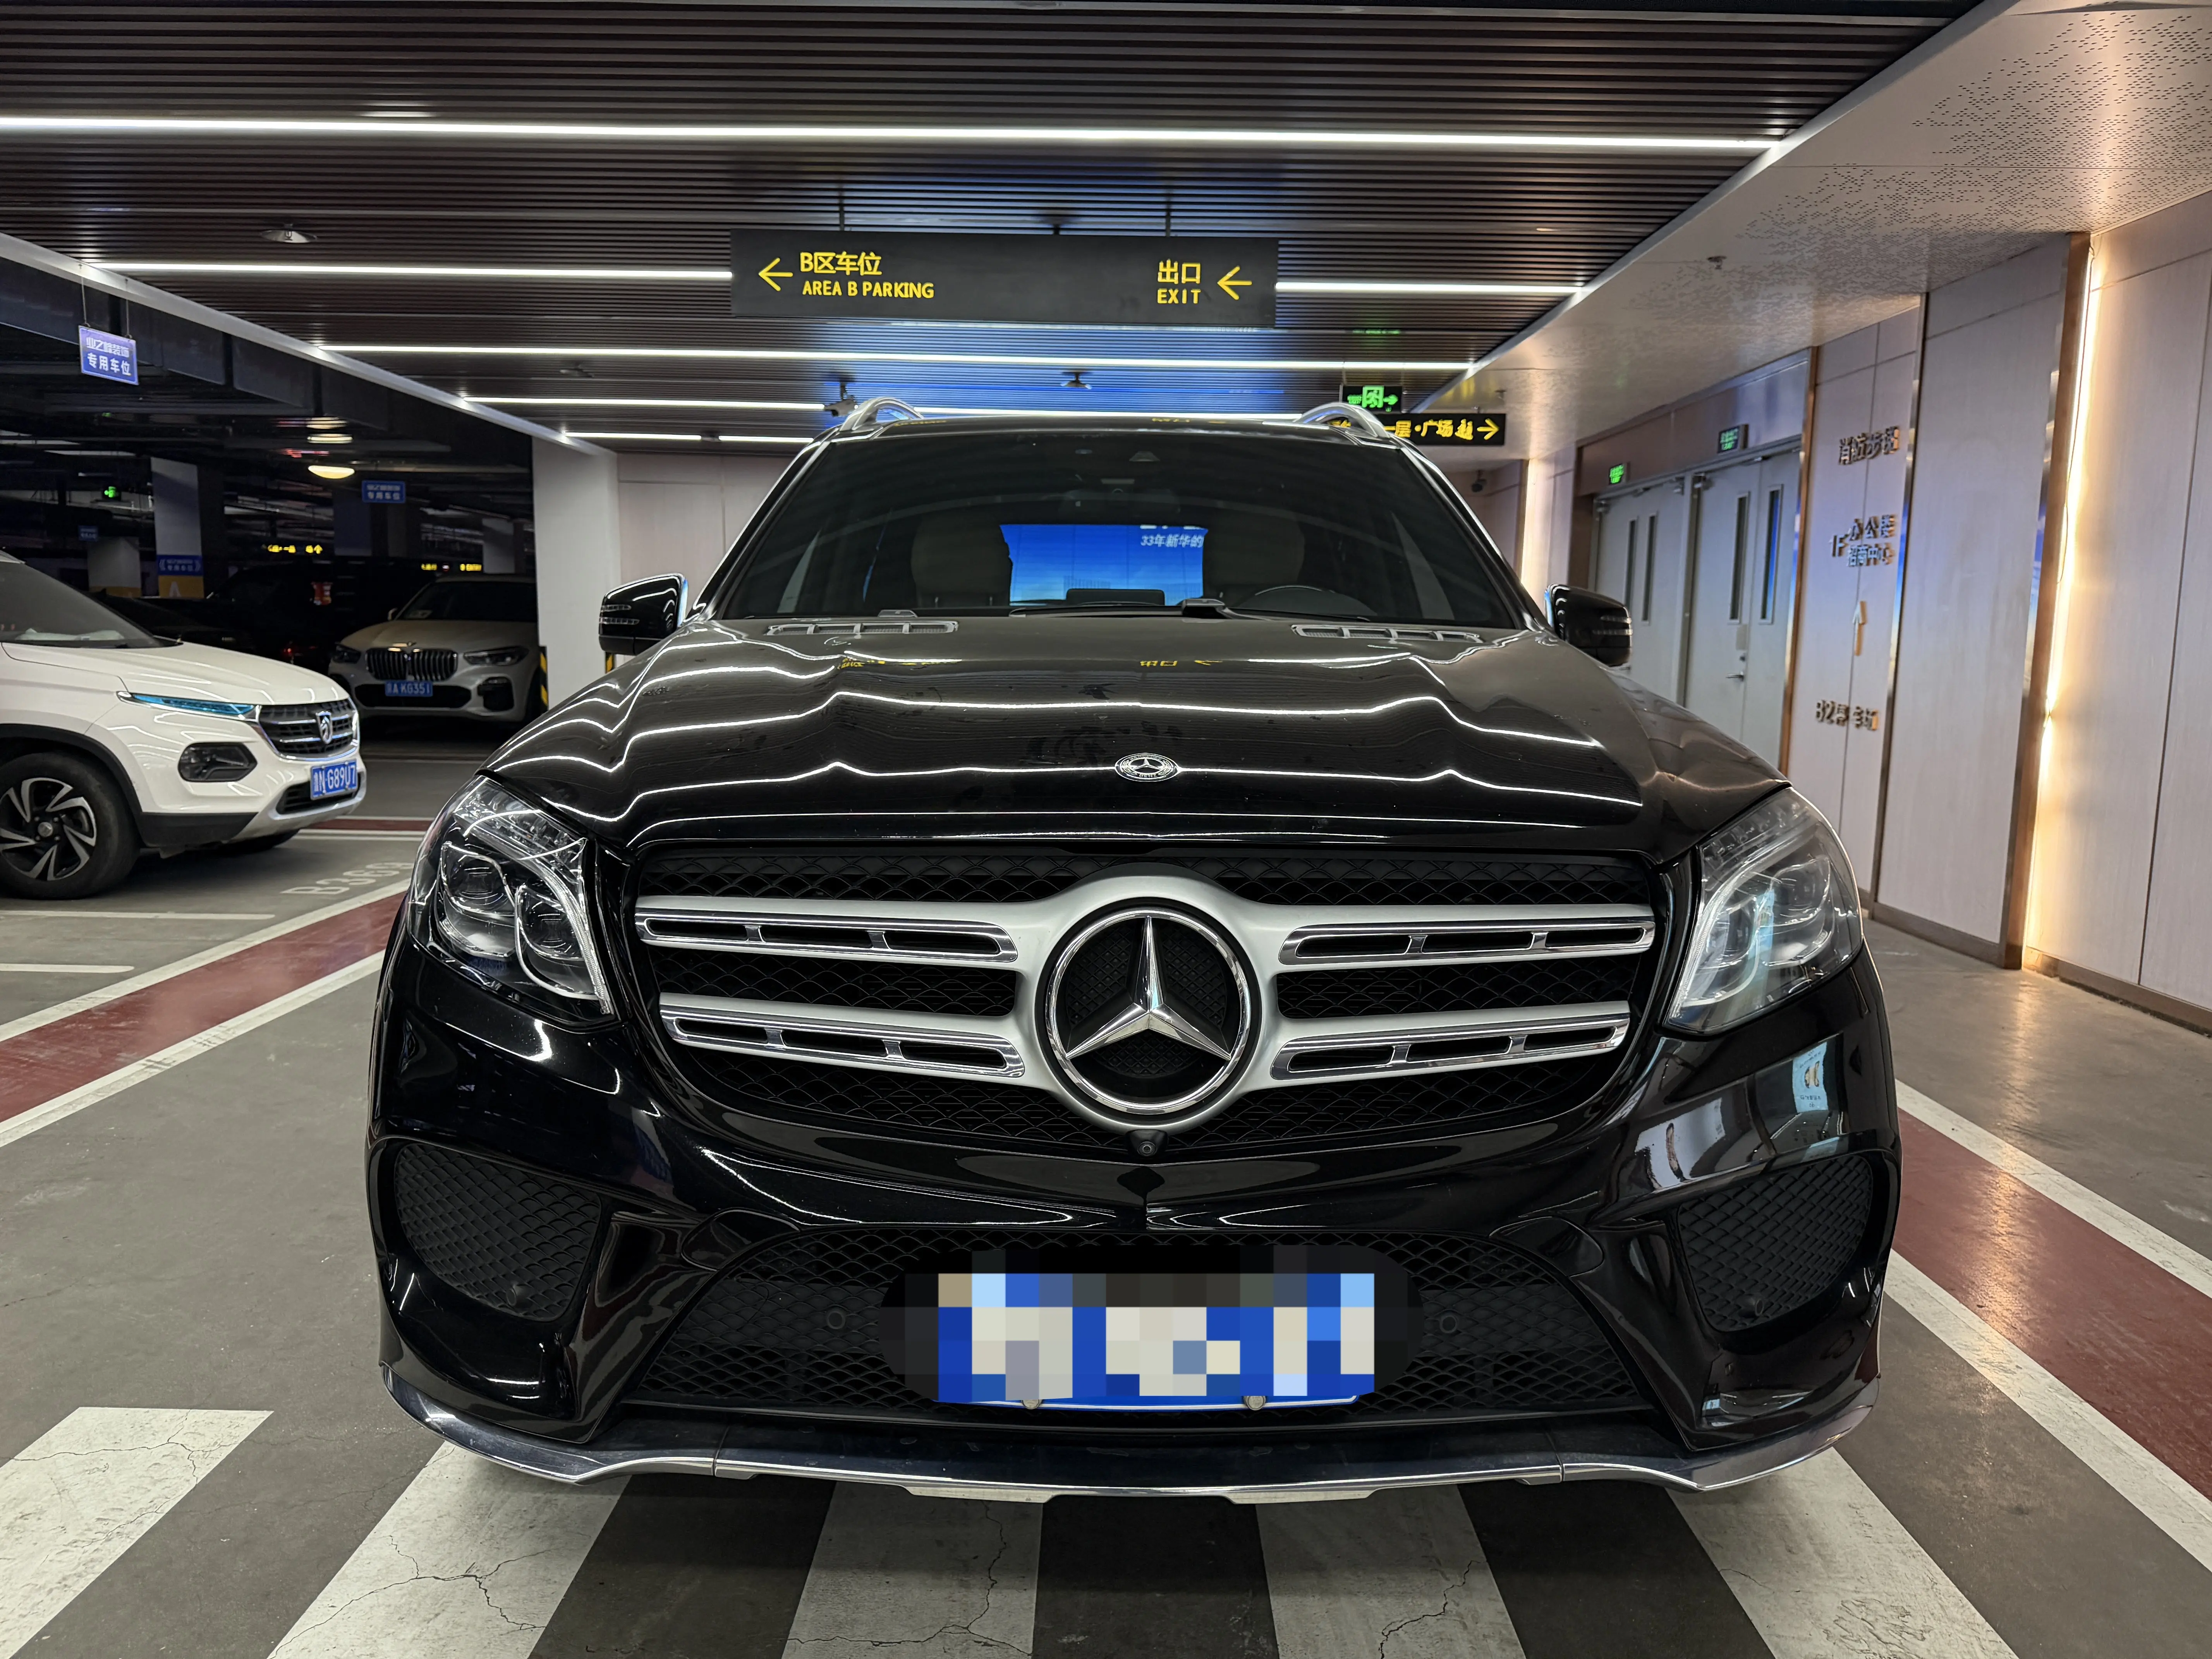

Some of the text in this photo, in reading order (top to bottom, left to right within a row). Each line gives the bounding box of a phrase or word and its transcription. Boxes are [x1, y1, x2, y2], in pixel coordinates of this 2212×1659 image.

[800, 251, 882, 276] B区车位
[1158, 258, 1200, 284] 出口
[802, 280, 934, 299] AREA B PARKING
[1157, 288, 1201, 304] EXIT
[87, 352, 132, 376] 专用车位
